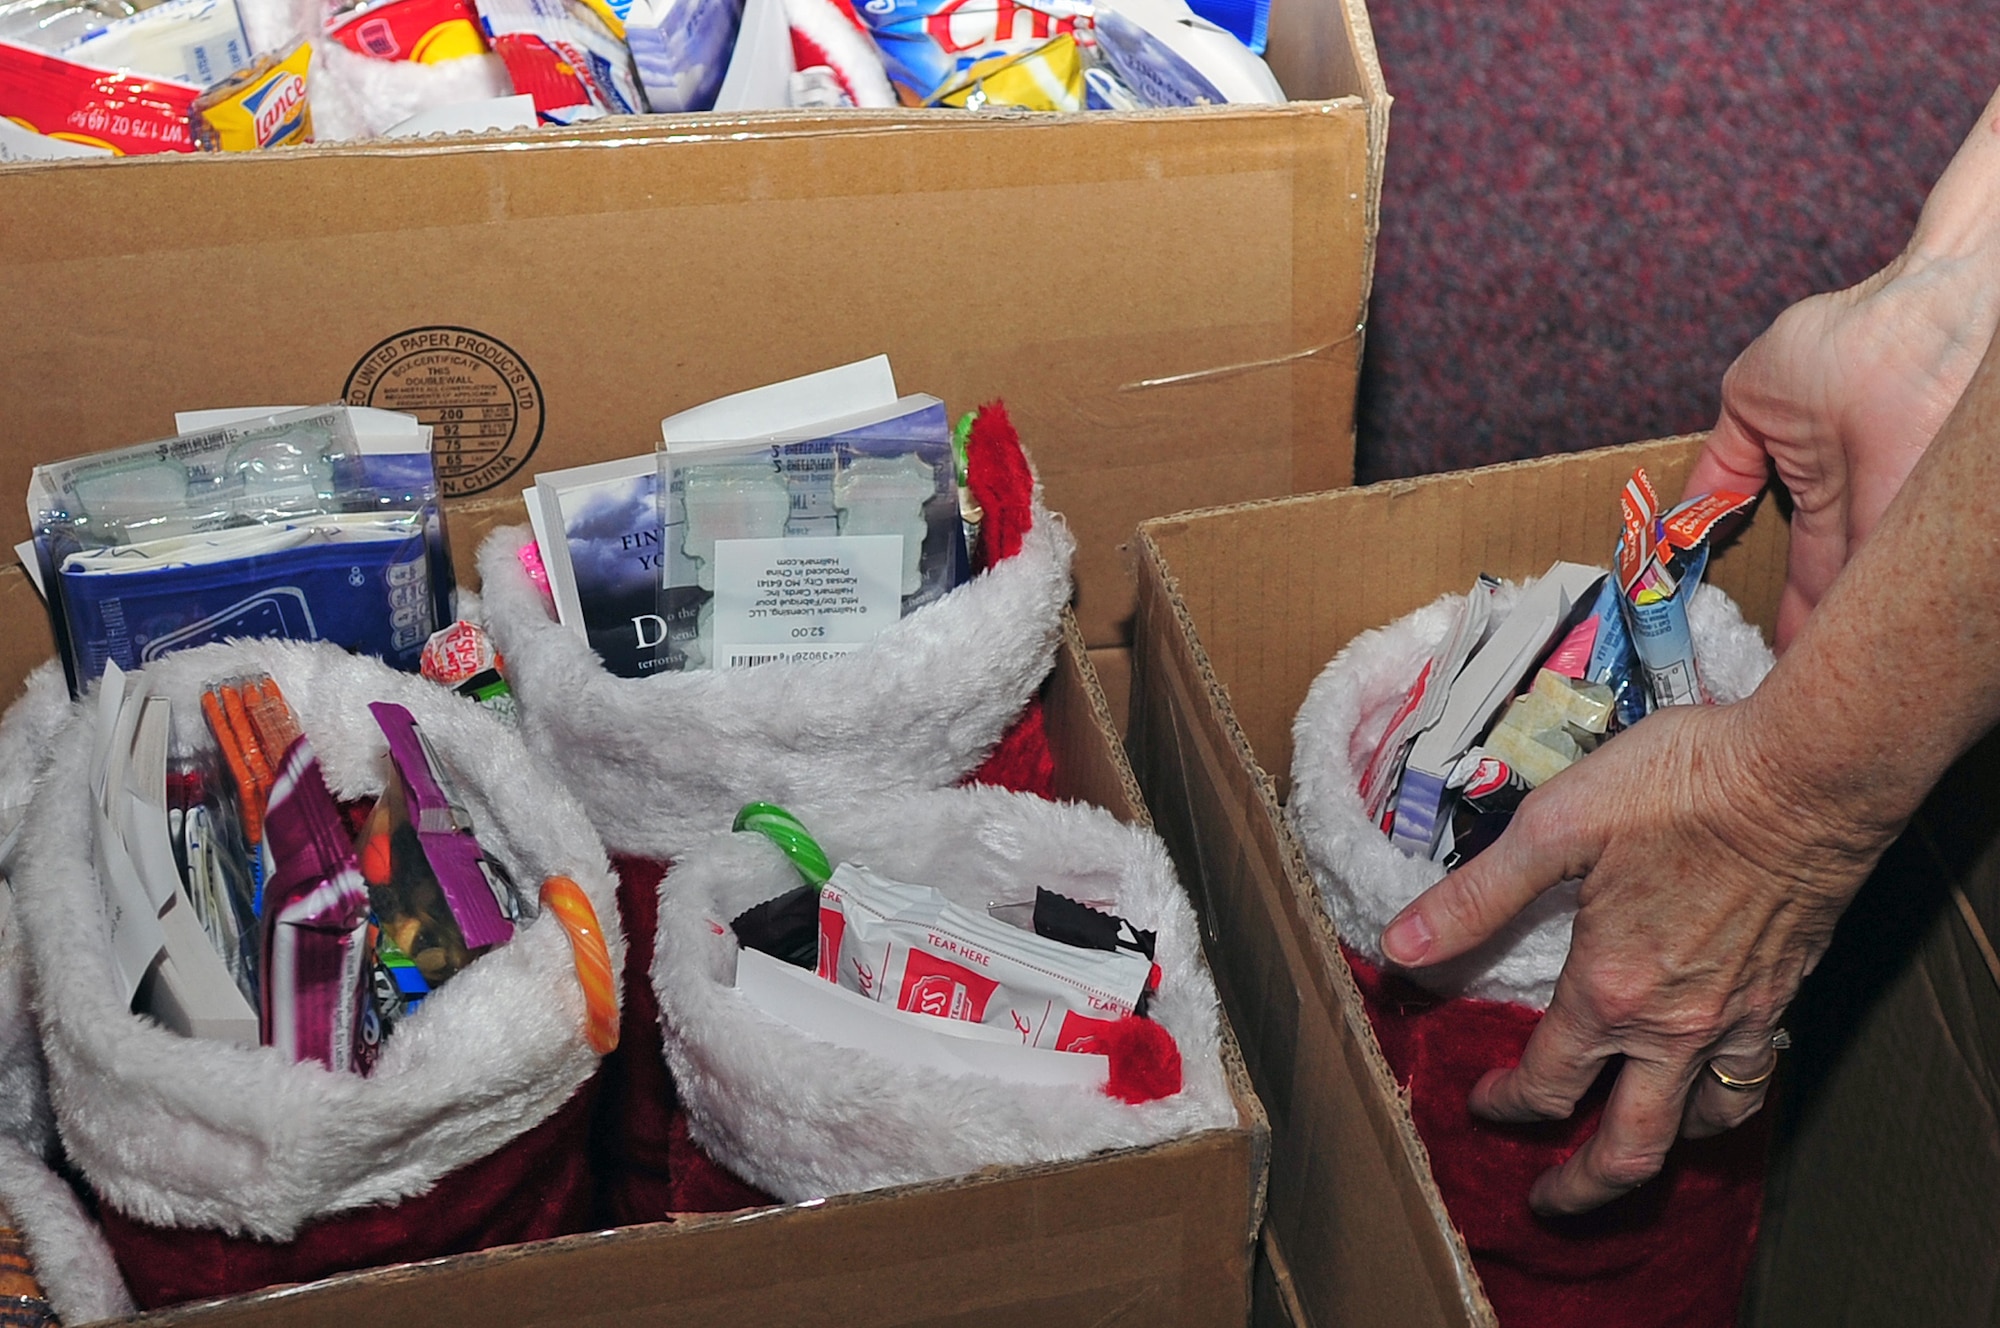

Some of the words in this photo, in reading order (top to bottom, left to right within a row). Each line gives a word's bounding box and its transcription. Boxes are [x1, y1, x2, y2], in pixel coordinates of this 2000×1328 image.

[255, 76, 306, 148] Lance
[110, 114, 130, 136] OZ
[132, 118, 158, 138] 1.75
[413, 355, 481, 372] CERTIFICATE
[358, 345, 398, 387] UNITED
[400, 333, 450, 353] PAPER
[454, 334, 526, 385] PRODUCTS
[516, 386, 535, 410] LTD
[427, 367, 451, 376] THIS
[440, 409, 464, 420] 200
[443, 425, 460, 435] 92
[445, 440, 461, 450] 75
[446, 454, 463, 464] 65
[463, 454, 518, 490] CHINA
[622, 529, 660, 551] FIN
[776, 557, 839, 566] Hallmark.com
[766, 568, 792, 577] China
[794, 568, 803, 576] in
[805, 567, 850, 576] Produced
[757, 579, 782, 588] 64141
[784, 579, 801, 587] MO
[825, 577, 858, 585] Kansas
[764, 588, 780, 597] Inc.
[782, 588, 812, 597] Cards,
[813, 587, 854, 596] Hallmark
[755, 599, 777, 607] pour
[748, 609, 767, 618] LLC
[769, 608, 815, 616] Licensing,
[817, 605, 857, 614] Hallmark
[791, 626, 825, 638] $2.00
[821, 888, 843, 904] ERE
[927, 933, 958, 952] TEAR
[958, 945, 991, 967] HERE
[1088, 995, 1118, 1013] TEAR
